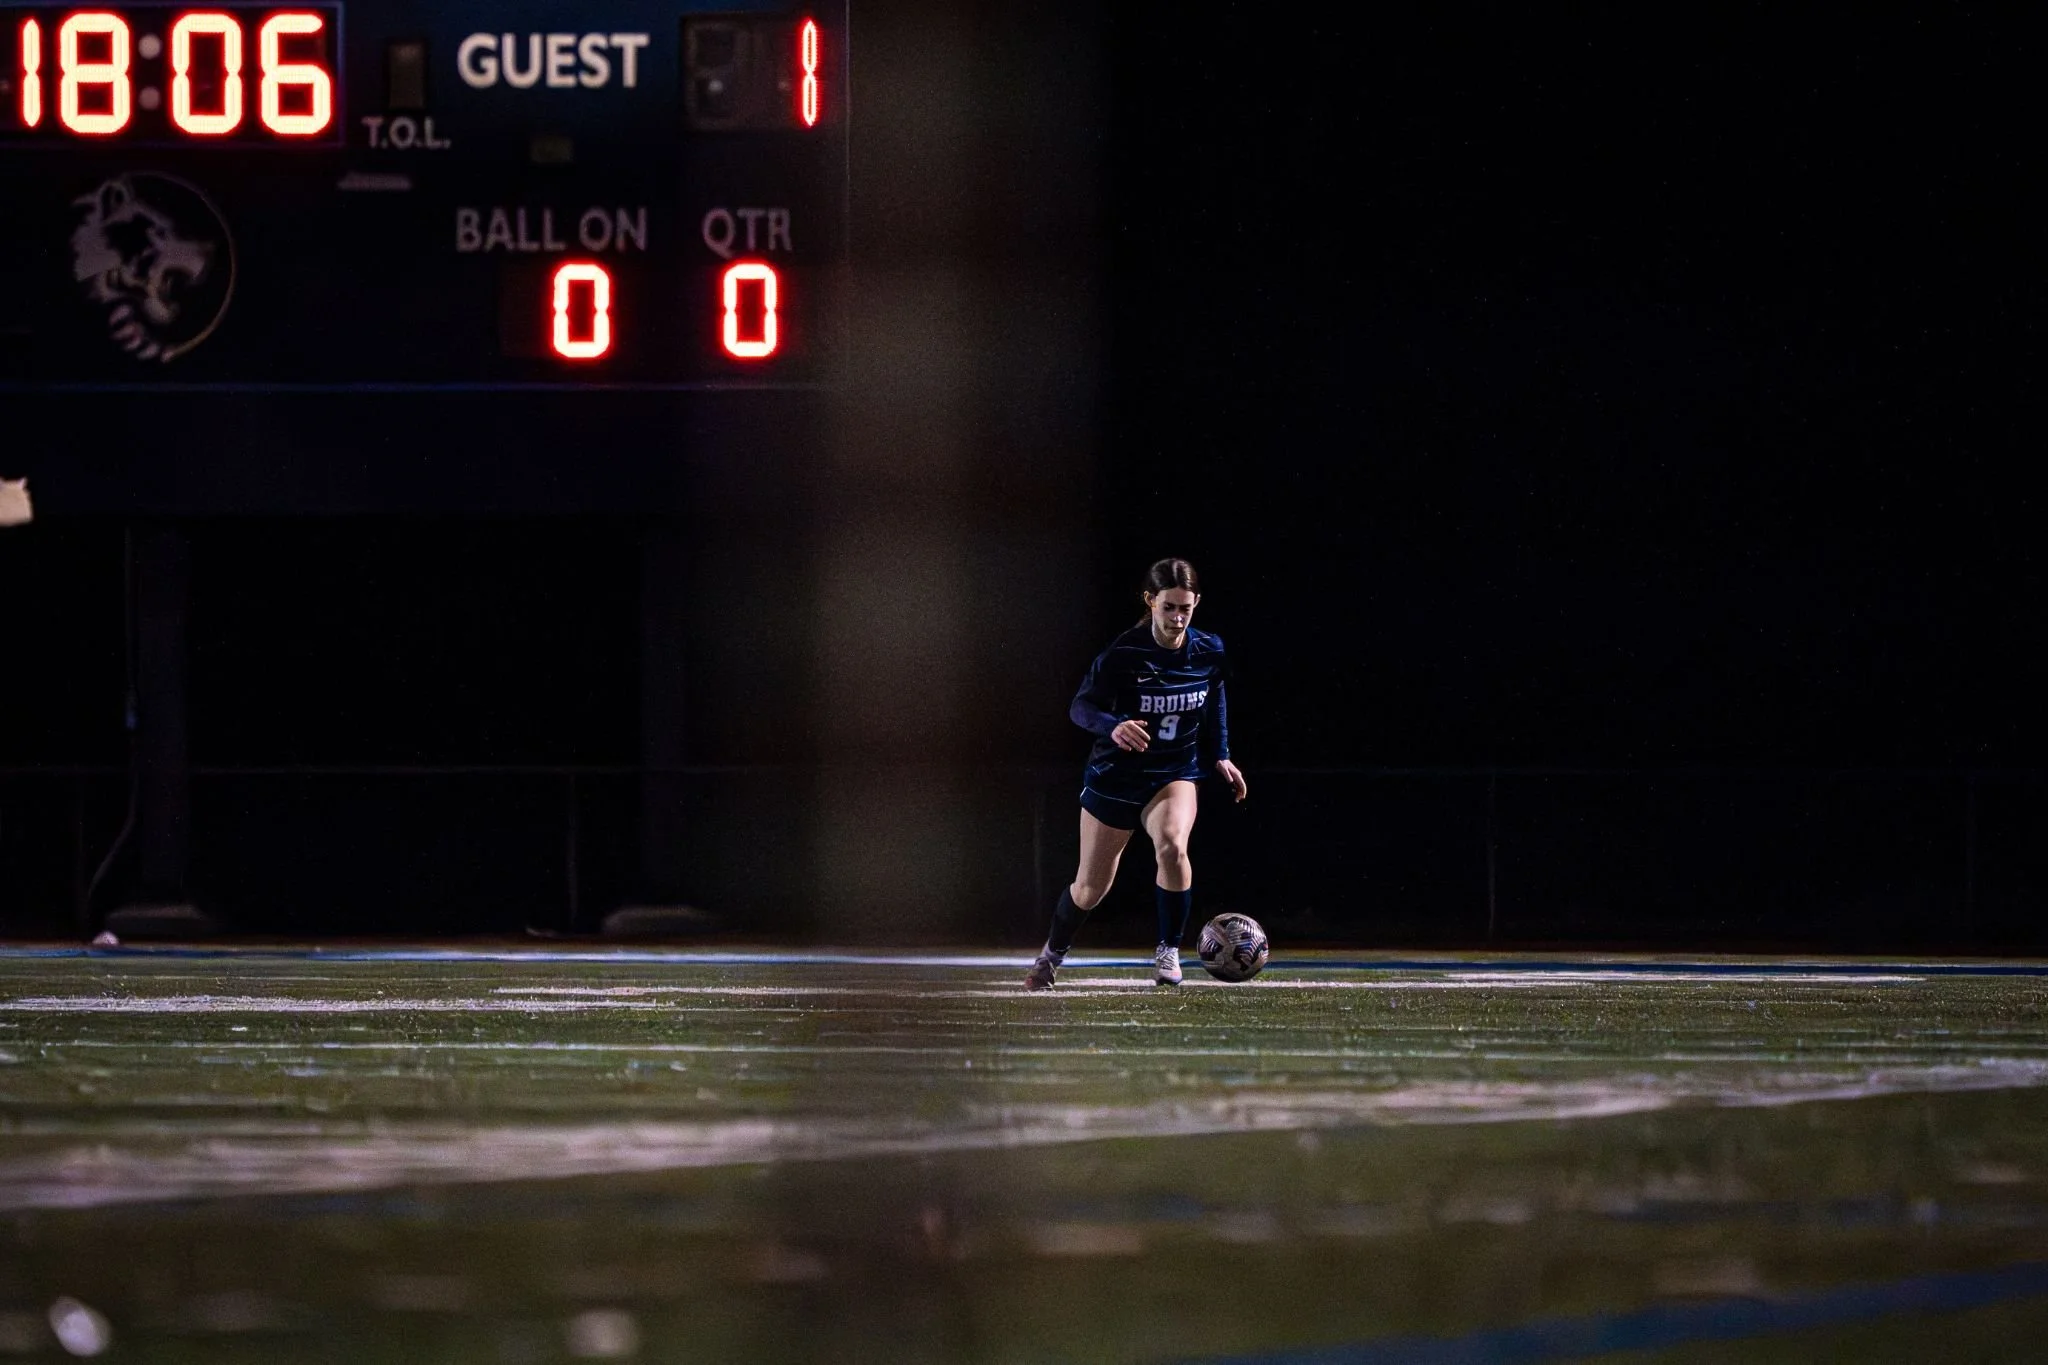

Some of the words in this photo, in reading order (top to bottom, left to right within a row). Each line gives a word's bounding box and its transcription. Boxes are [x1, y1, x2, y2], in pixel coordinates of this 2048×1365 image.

[20, 11, 332, 136] 18:06
[457, 32, 650, 89] GUEST
[800, 18, 819, 128] 1
[362, 116, 451, 150] T.O.L.
[456, 207, 566, 252] BALL
[579, 207, 648, 252] ON
[702, 207, 793, 257] QTR
[552, 262, 611, 359] 0
[722, 262, 779, 359] 0
[1139, 690, 1208, 714] BRUINS
[1157, 715, 1180, 741] 9
